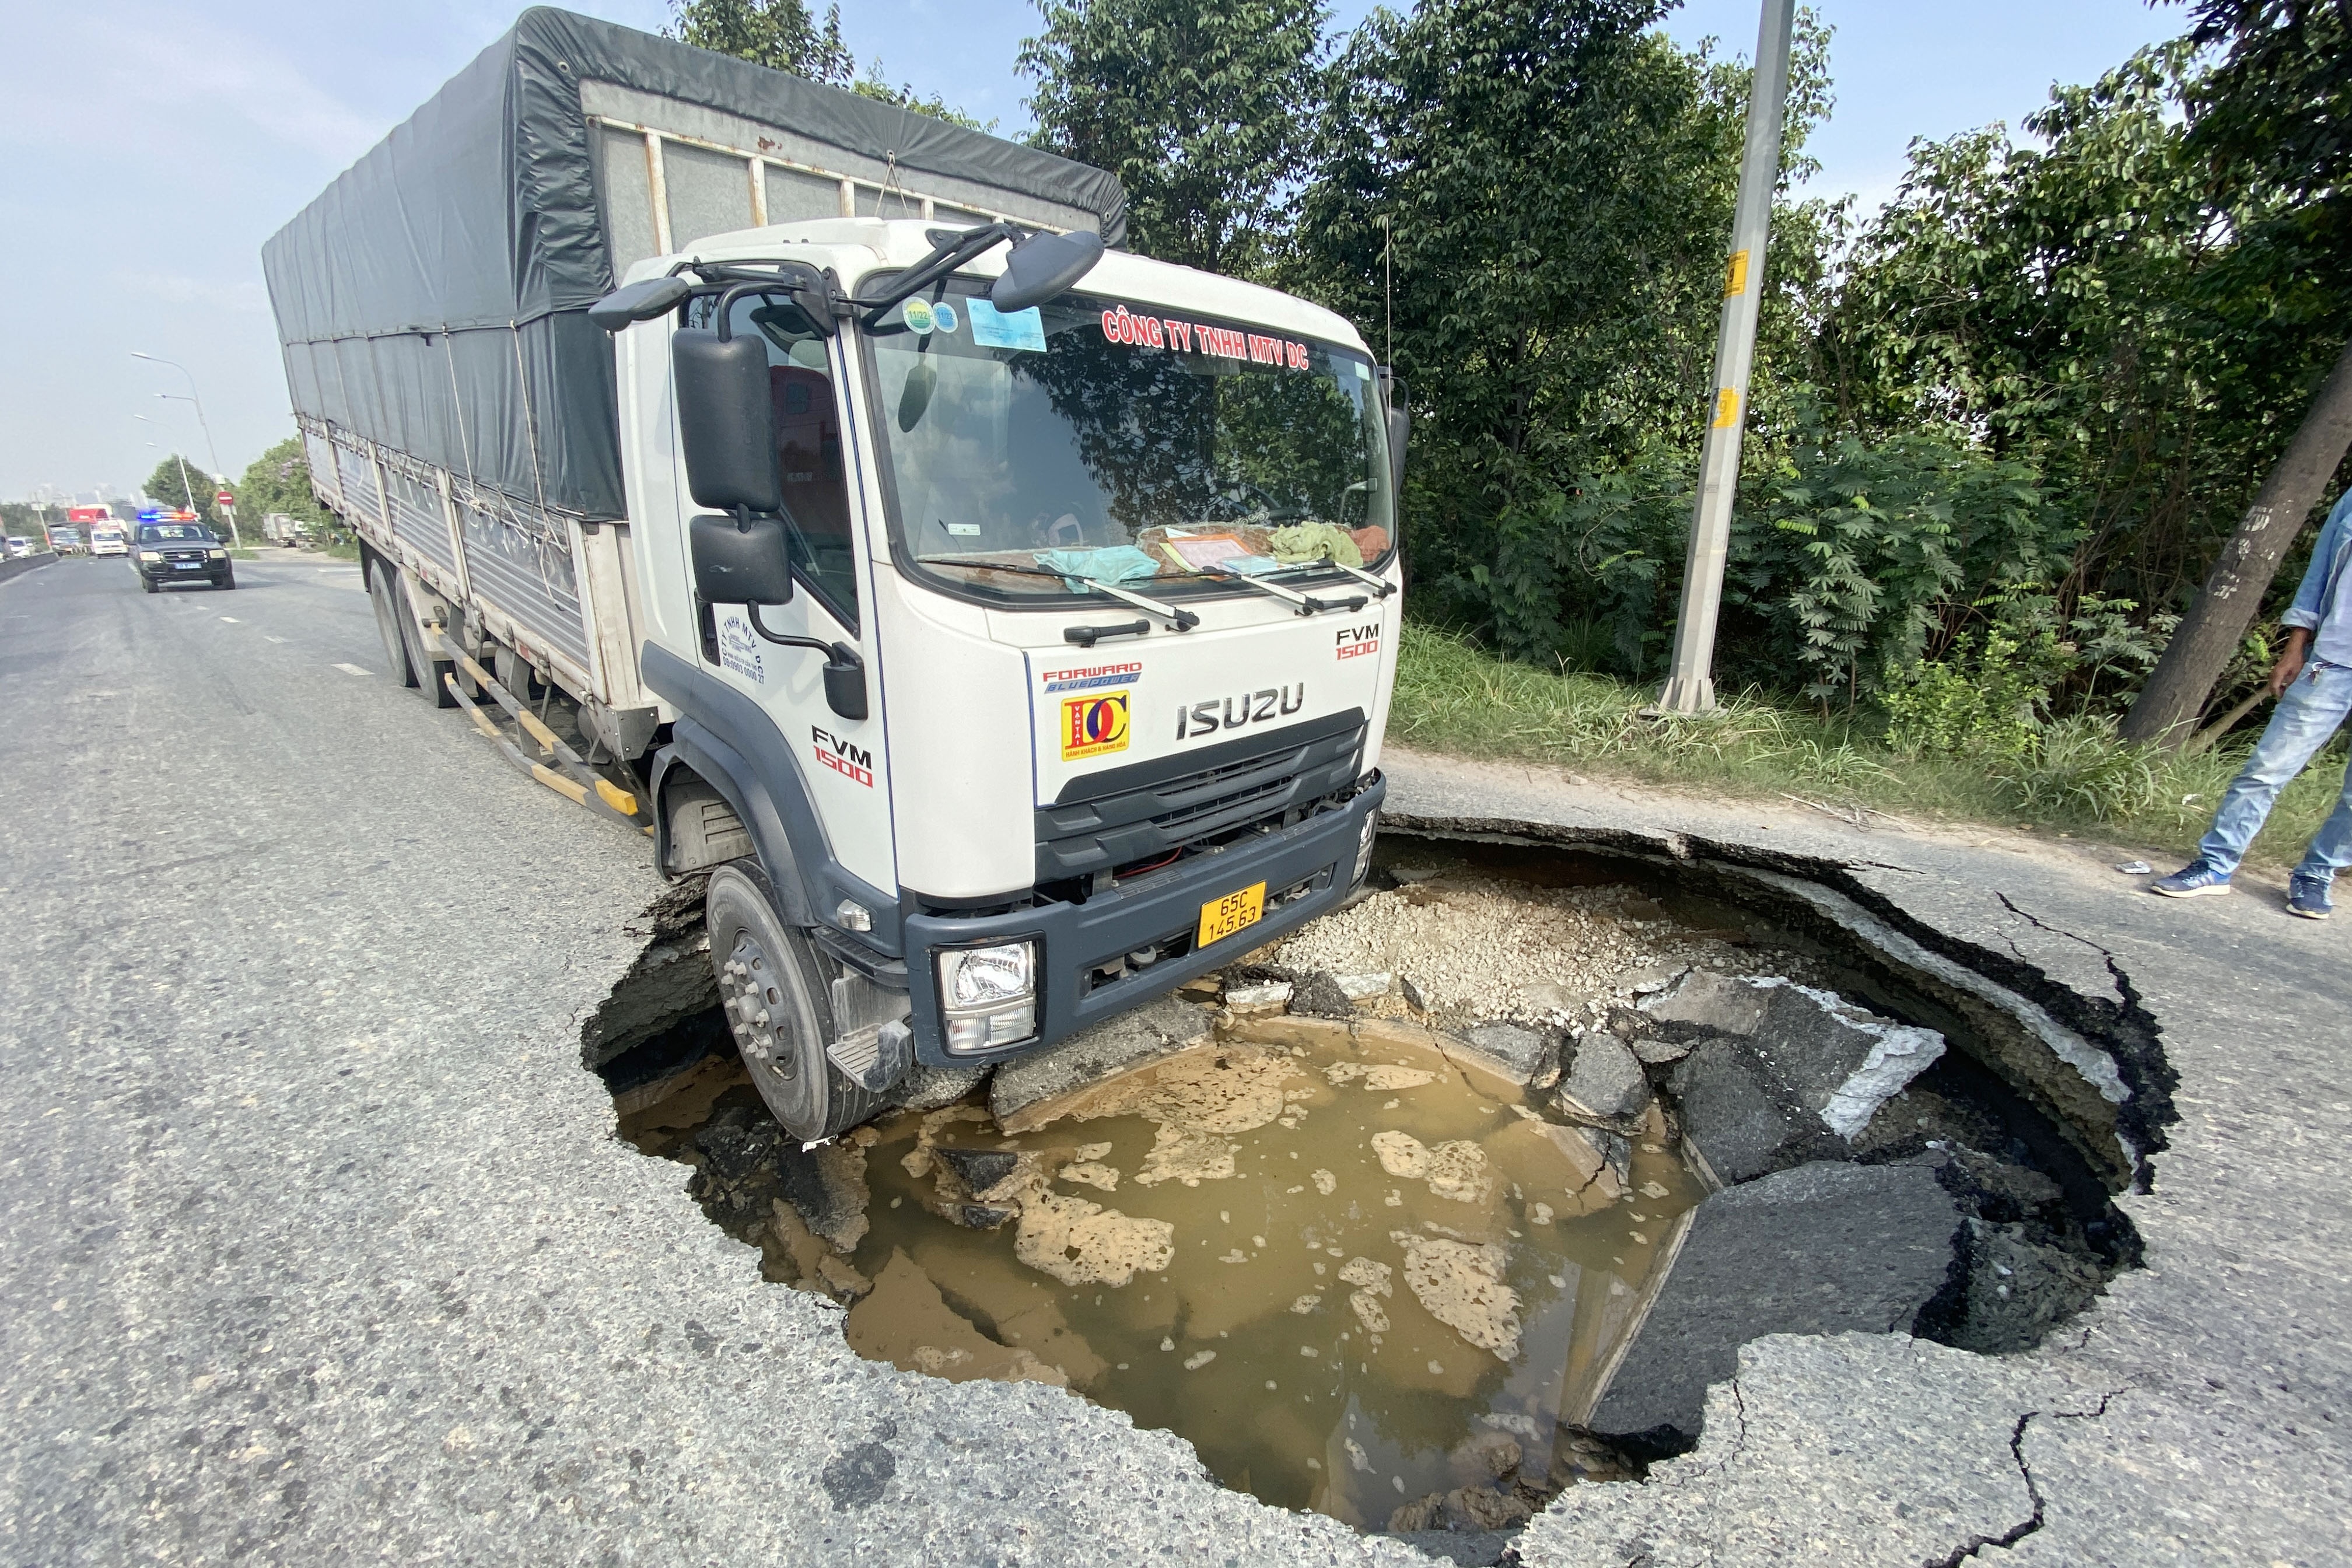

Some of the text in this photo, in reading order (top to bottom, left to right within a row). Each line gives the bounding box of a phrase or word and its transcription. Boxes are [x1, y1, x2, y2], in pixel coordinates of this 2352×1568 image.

[909, 310, 928, 320] 11/22
[937, 312, 954, 320] 11/22
[1102, 304, 1309, 370] CÔNG TY TNHH MTV DC
[1336, 623, 1379, 645] FVM
[1336, 640, 1378, 660] 1500
[1043, 662, 1142, 682] FORWARD
[1176, 681, 1304, 741] ISUZU
[811, 724, 872, 769] FVM
[813, 745, 873, 789] 1500
[1221, 891, 1248, 916] 65C
[1209, 906, 1256, 940] 145.63
